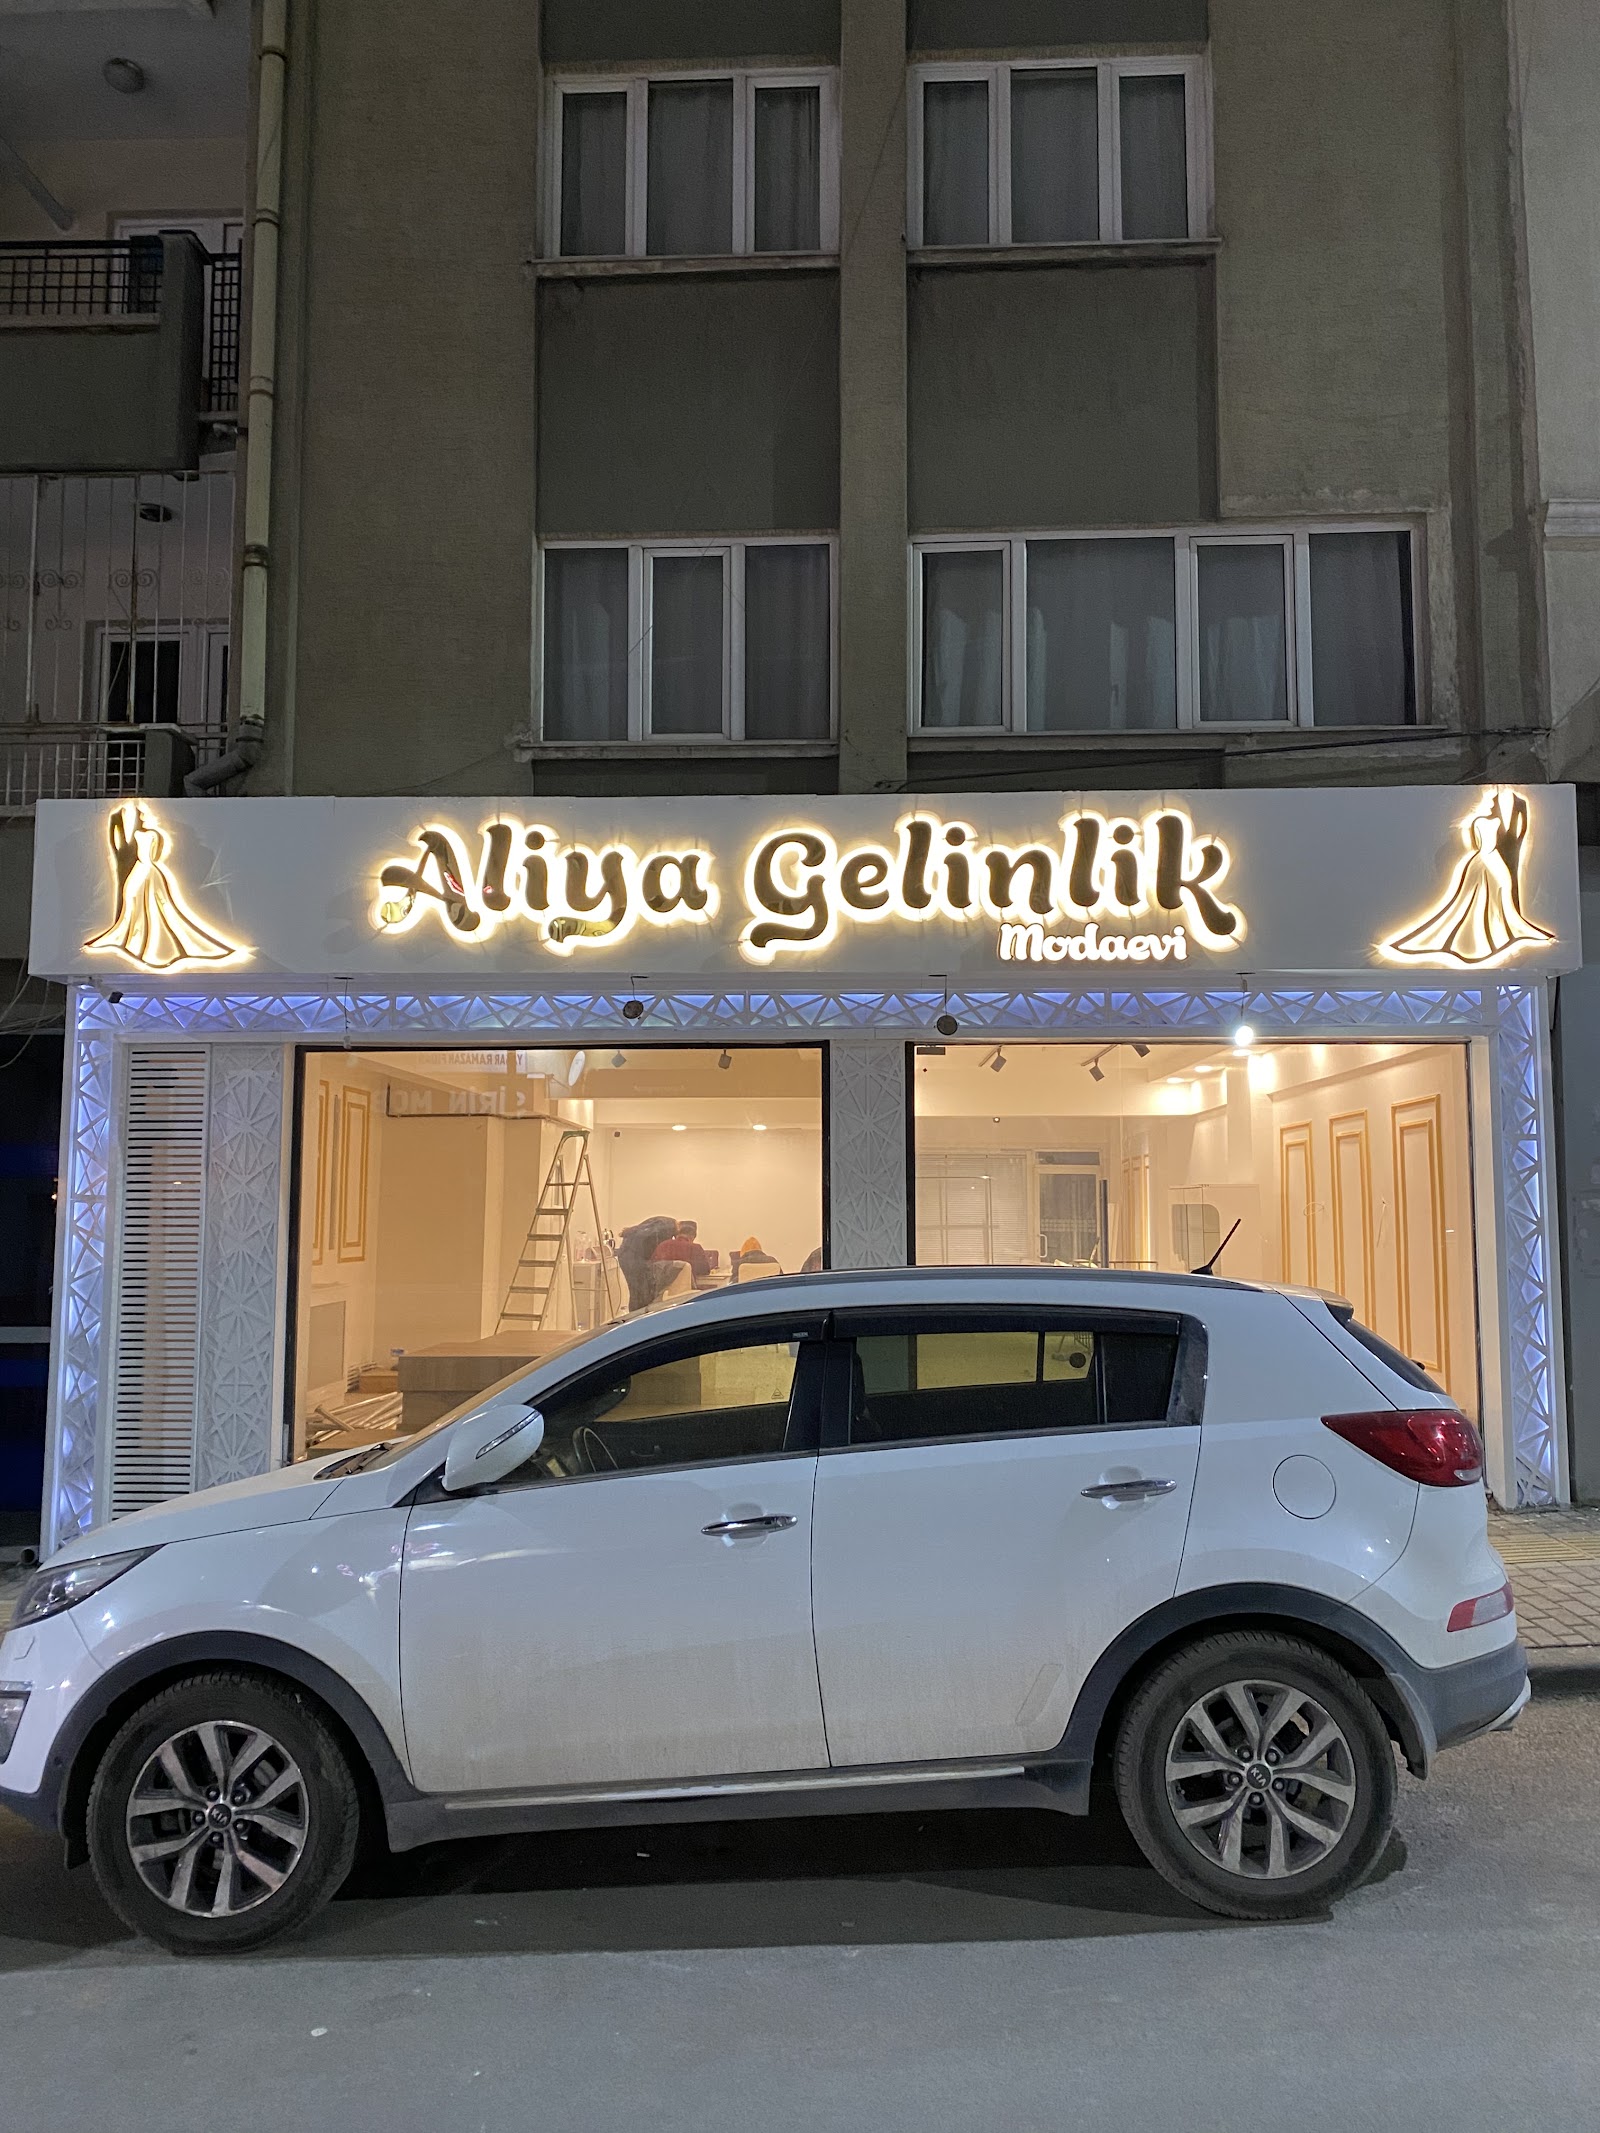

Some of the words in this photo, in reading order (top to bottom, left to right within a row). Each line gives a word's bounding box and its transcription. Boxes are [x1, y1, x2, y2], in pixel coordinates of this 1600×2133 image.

[380, 823, 708, 942] Aliya
[750, 814, 1237, 948] Gelinlik
[999, 921, 1188, 962] Modaevi
[1250, 1767, 1267, 1787] KIA
[211, 1808, 228, 1825] KIA
